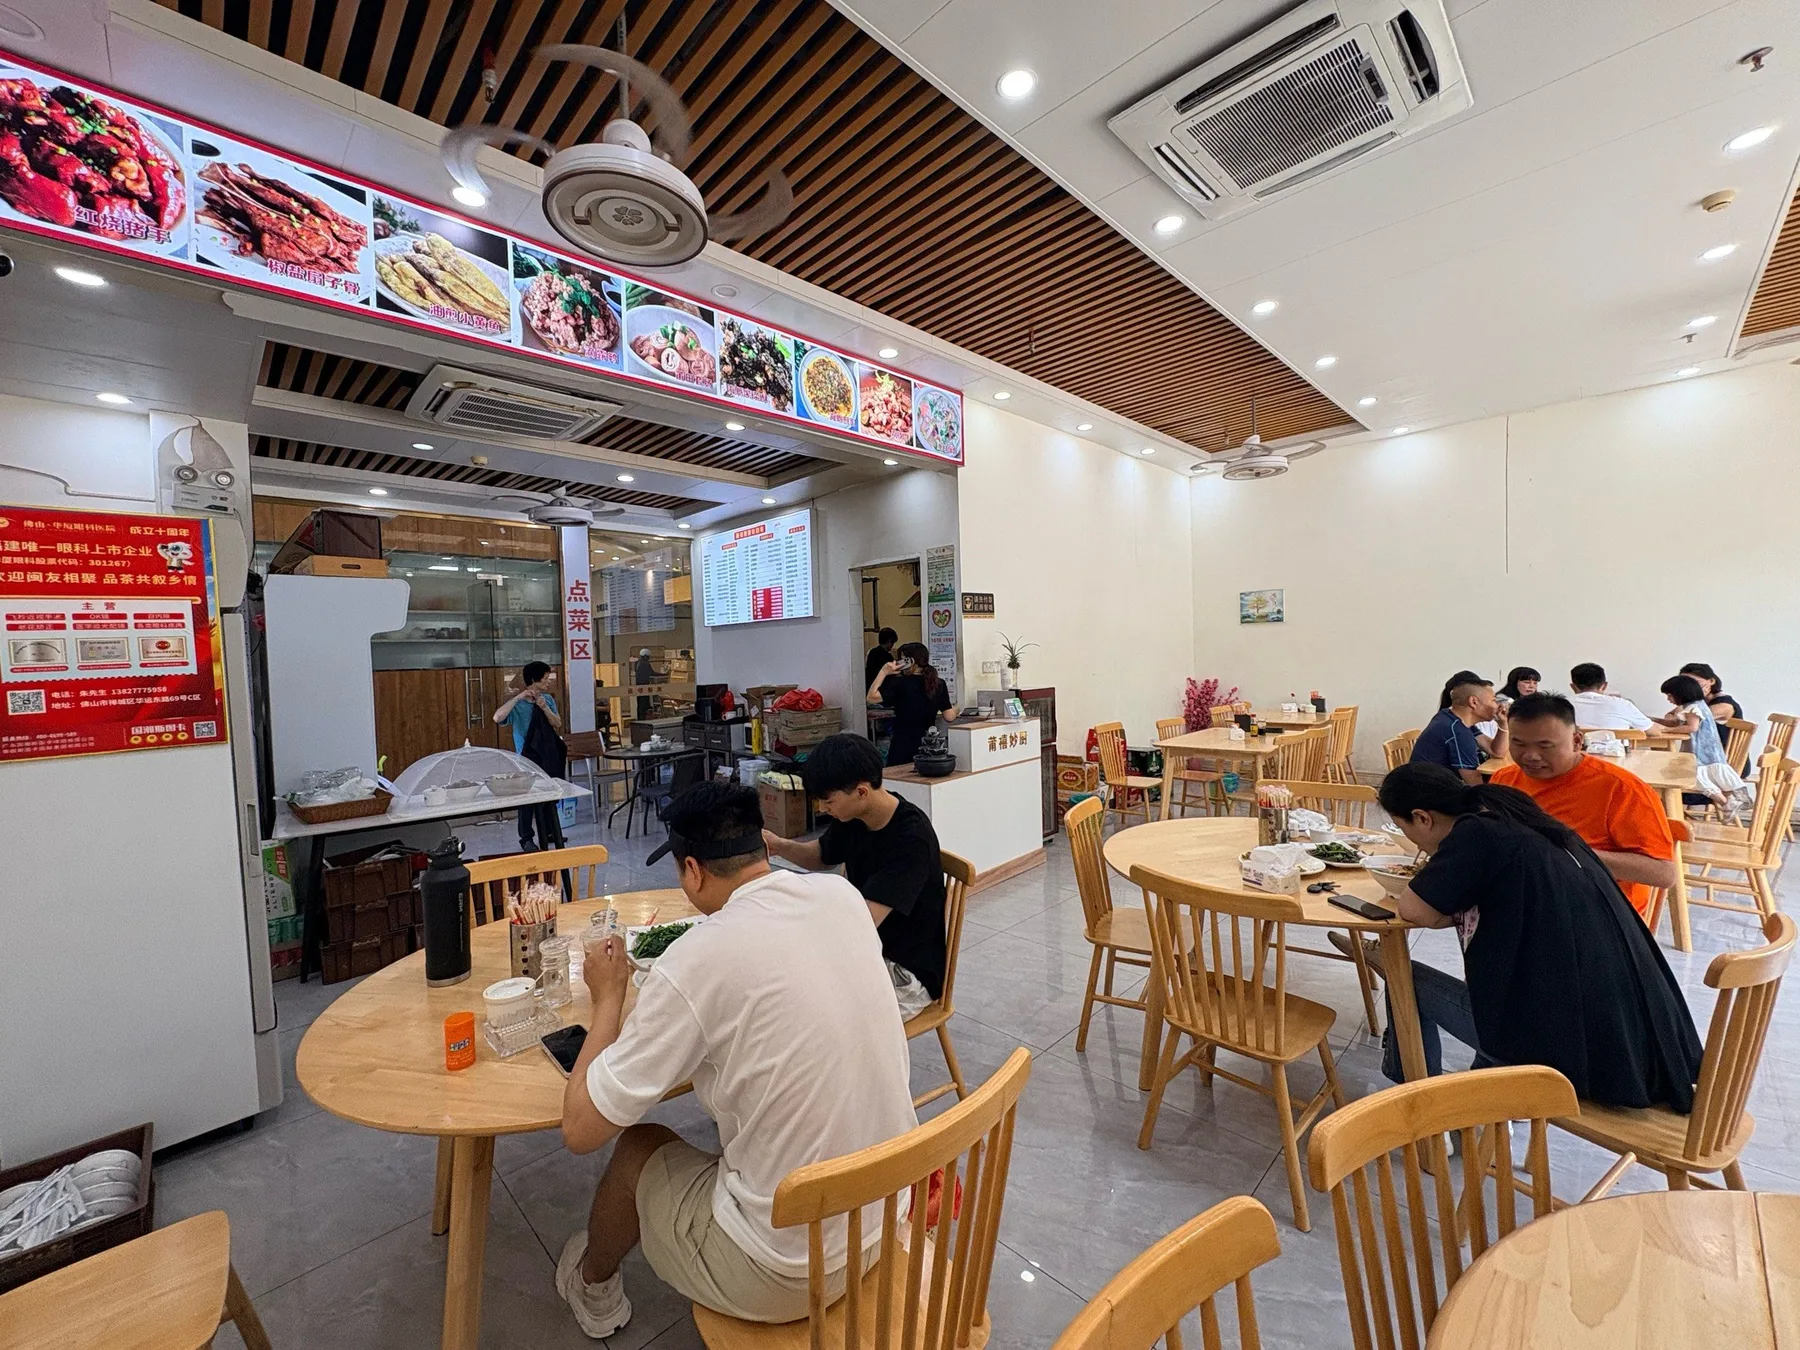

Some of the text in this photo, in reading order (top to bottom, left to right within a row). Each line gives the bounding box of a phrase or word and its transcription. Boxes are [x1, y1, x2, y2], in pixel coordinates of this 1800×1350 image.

[75, 206, 172, 244] 红烧猪手
[268, 259, 360, 295] 椒盐扇子骨
[429, 303, 501, 333] 油煎小黄鱼
[130, 526, 190, 537] 成立十周年
[0, 540, 153, 557] 建唯一眼科上市企业
[103, 573, 197, 586] 品茶共叙乡情
[567, 579, 591, 660] 点菜区
[987, 730, 1028, 753] 莆禧妙厨
